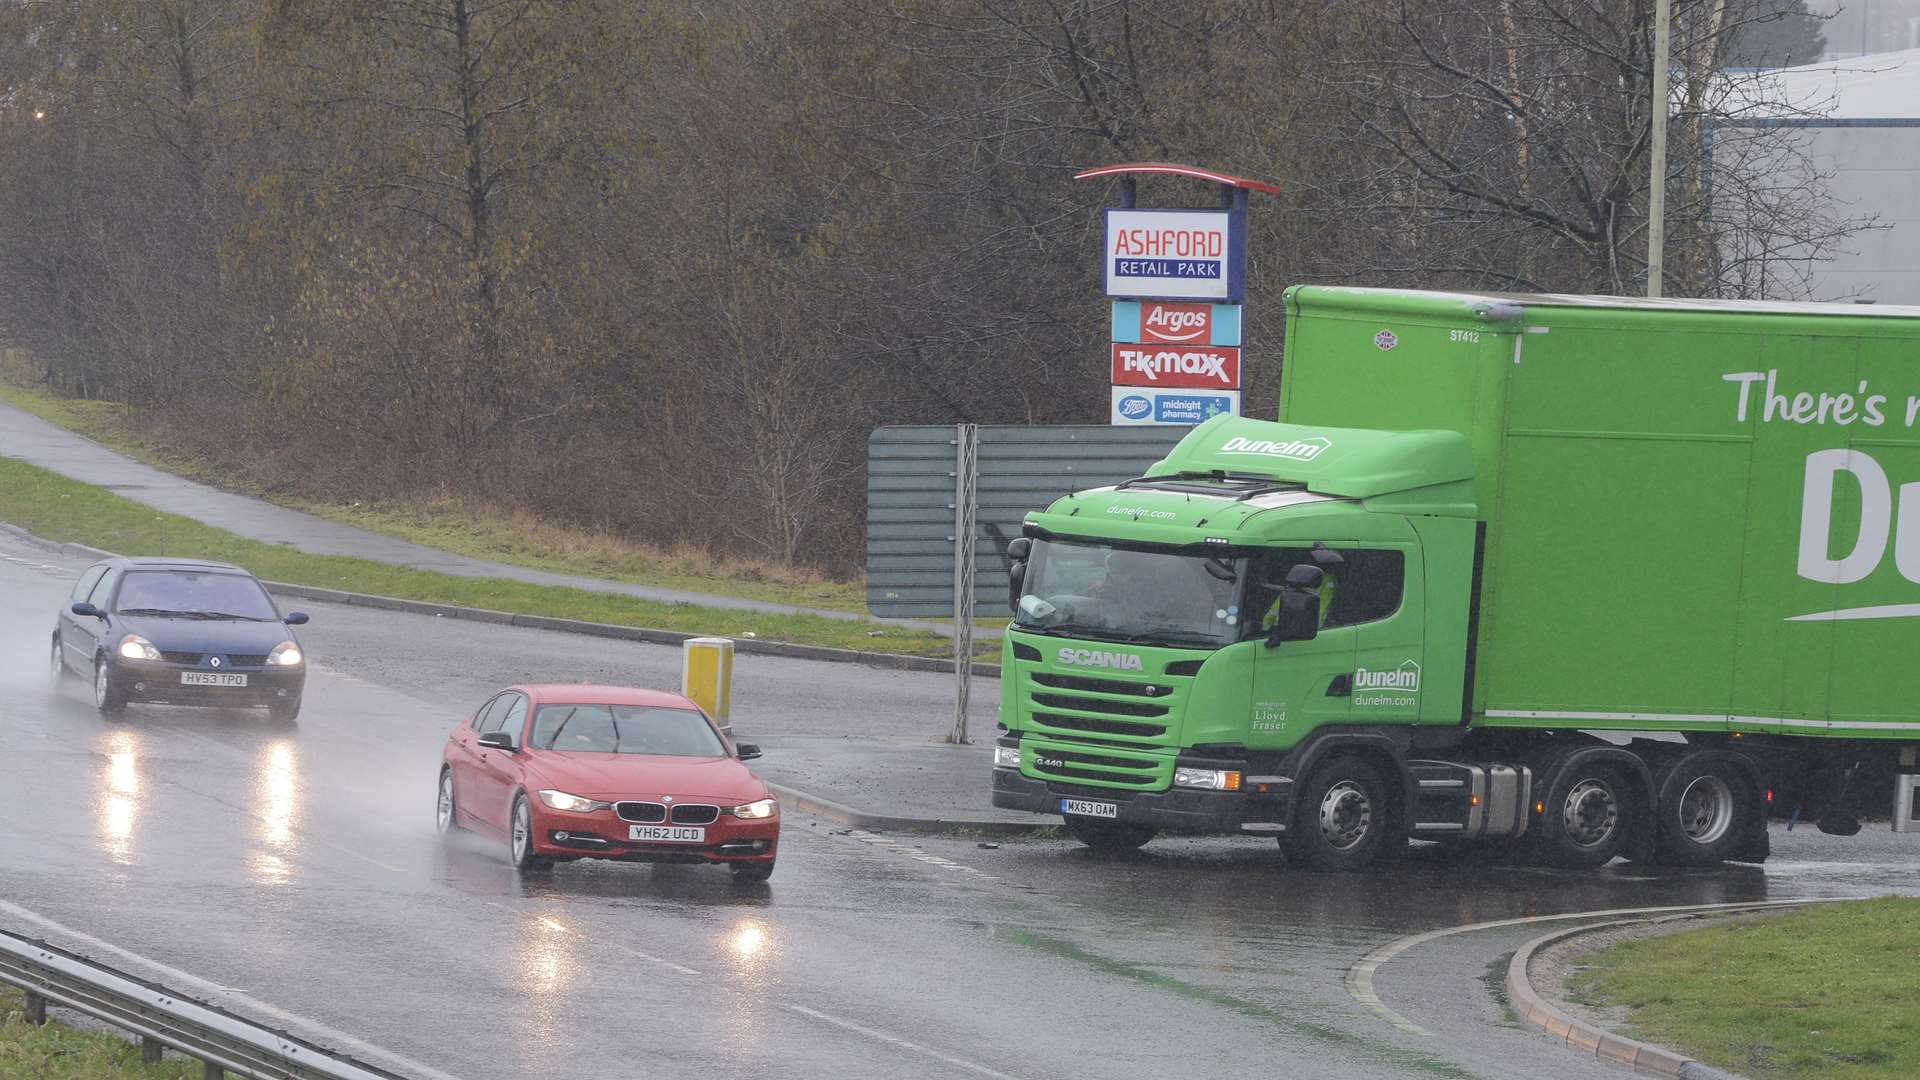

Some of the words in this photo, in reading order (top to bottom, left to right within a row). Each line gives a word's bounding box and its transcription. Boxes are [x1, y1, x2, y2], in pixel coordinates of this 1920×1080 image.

[1115, 229, 1222, 257] ASHFORD
[1120, 261, 1171, 275] RETAIL
[1178, 263, 1216, 276] PARK
[1146, 305, 1206, 332] Argos
[1450, 330, 1479, 343] ST412
[1722, 368, 1887, 426] There's
[1163, 400, 1201, 411] midnight
[1163, 409, 1201, 420] pharmacy
[1221, 437, 1320, 457] Dunelm
[1106, 504, 1176, 519] dunelm.com
[1057, 647, 1144, 672] SCANIA
[186, 673, 217, 684] HV53
[1355, 667, 1416, 687] Dunelm
[1355, 694, 1416, 706] dunelm.com
[1255, 710, 1286, 721] Lloyd
[1252, 720, 1286, 730] Fraser
[1068, 801, 1093, 813] MX63
[1095, 804, 1115, 816] OAM
[635, 827, 670, 839] YH62
[673, 829, 699, 840] UCD
